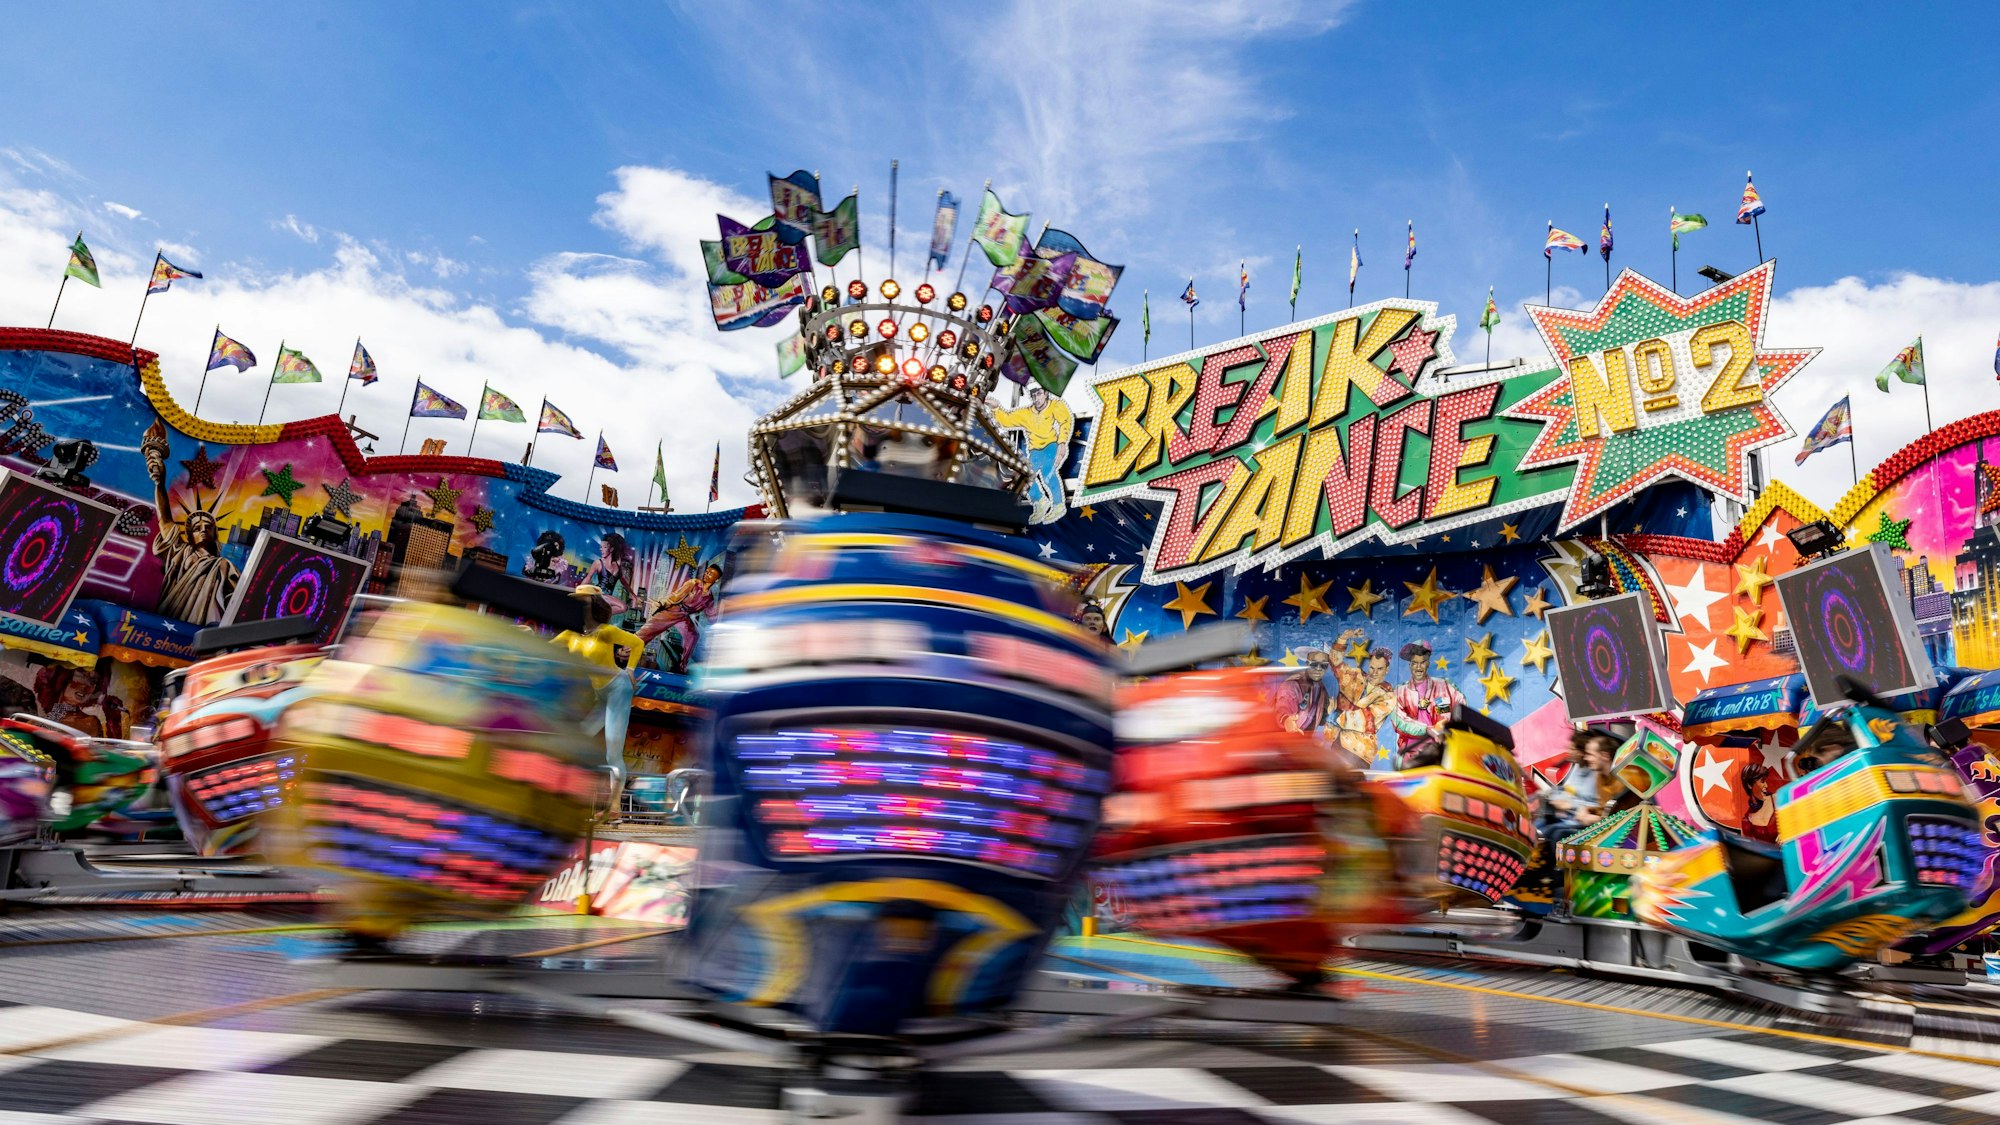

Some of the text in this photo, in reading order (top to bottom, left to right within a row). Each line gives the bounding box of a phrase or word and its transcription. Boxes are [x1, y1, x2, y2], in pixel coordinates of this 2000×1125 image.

[1689, 319, 1763, 414] 2
[1085, 307, 1421, 487] BREAK
[1147, 381, 1503, 573] DANCE
[129, 630, 153, 647] It's
[1695, 701, 1721, 719] Funk
[1722, 697, 1746, 716] and
[1958, 689, 1990, 714] Let's
